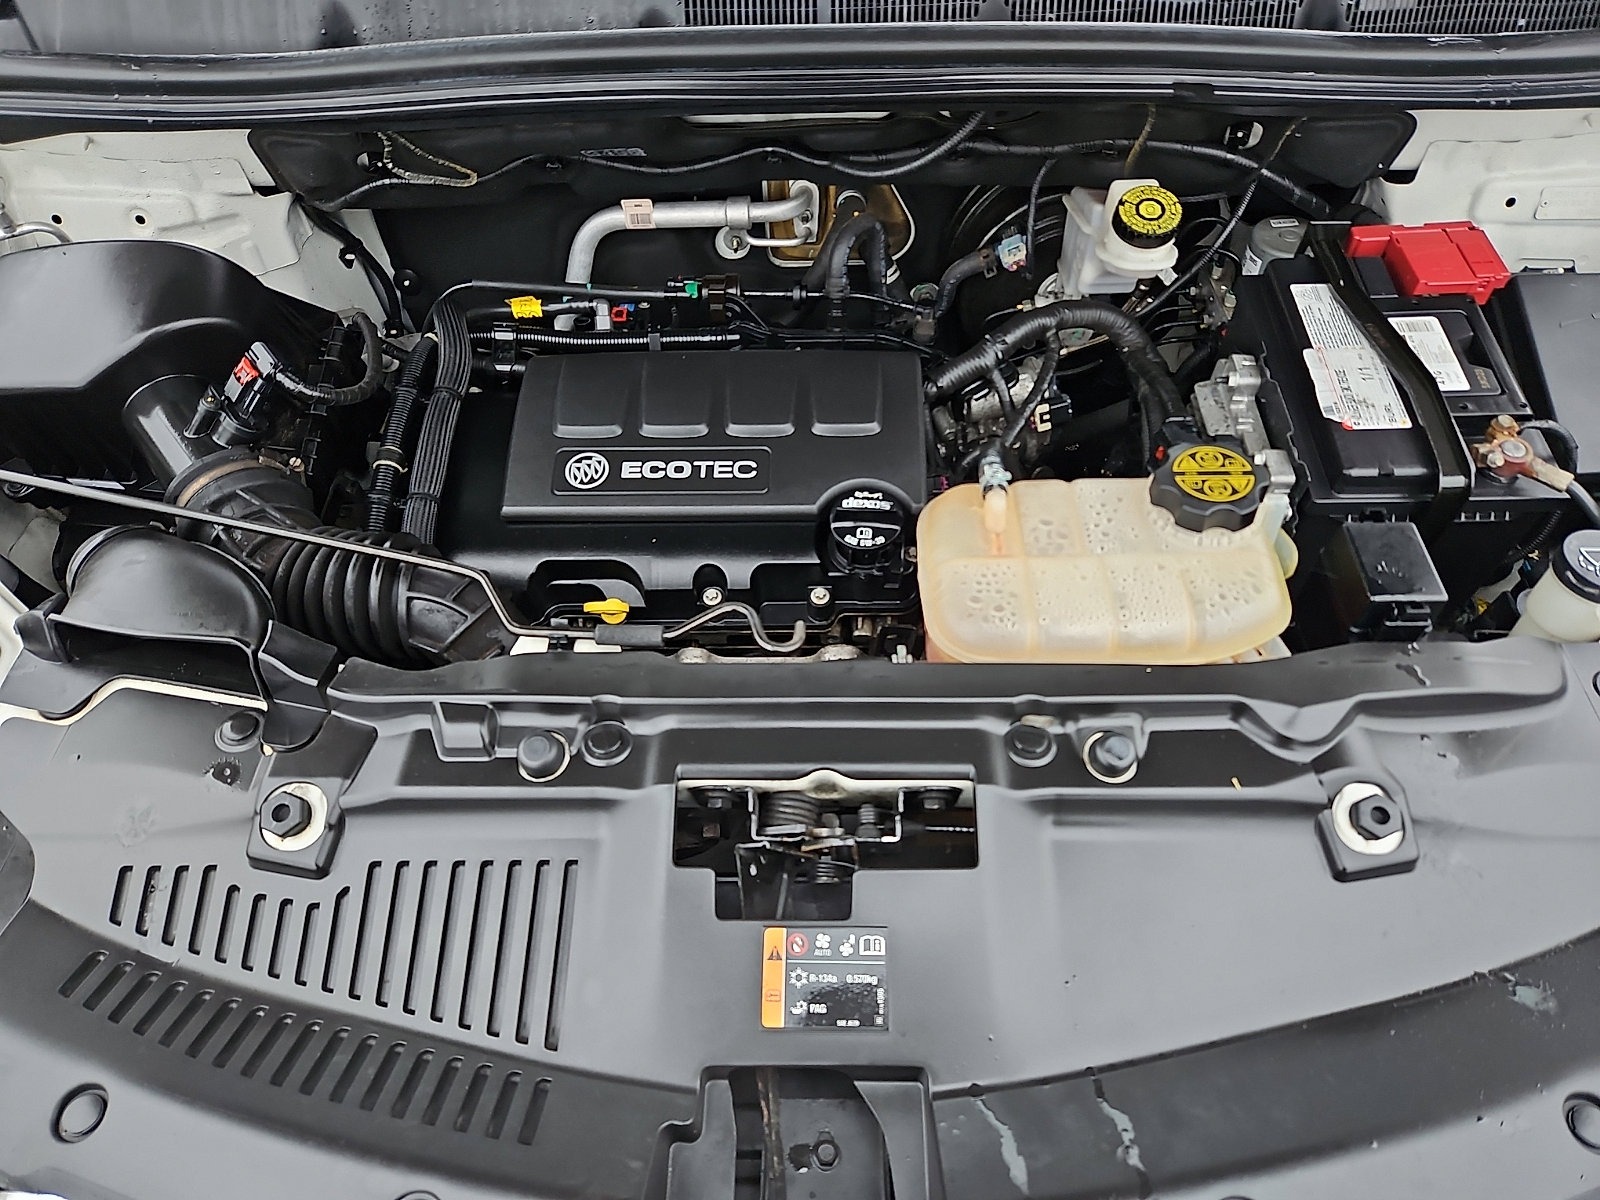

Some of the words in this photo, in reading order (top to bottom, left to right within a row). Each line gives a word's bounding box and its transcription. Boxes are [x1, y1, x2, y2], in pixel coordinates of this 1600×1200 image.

[620, 460, 758, 479] ECOTEC
[814, 948, 832, 957] AUTO
[809, 973, 838, 983] R-134a
[809, 1003, 827, 1013] PAG
